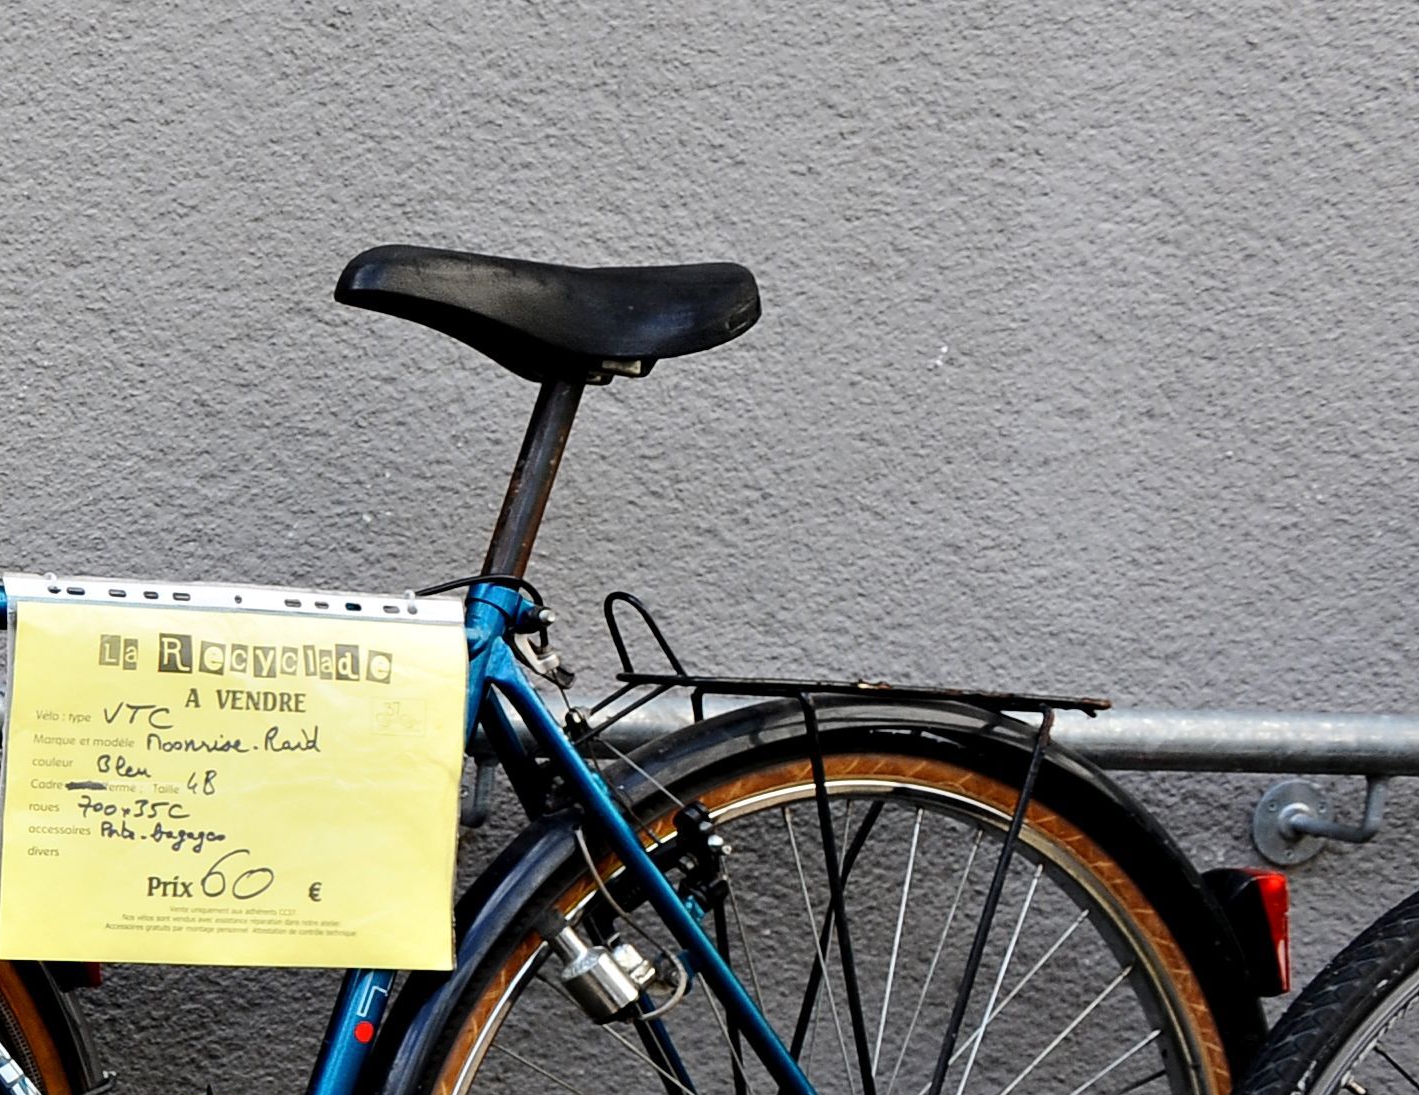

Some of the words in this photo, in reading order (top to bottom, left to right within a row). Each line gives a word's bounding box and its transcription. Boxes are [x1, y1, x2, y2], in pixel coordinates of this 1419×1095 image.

[158, 633, 393, 684] Recyclade
[185, 688, 201, 708] A
[216, 688, 307, 713] VENDRE
[68, 711, 91, 724] type
[104, 701, 174, 730] VTC
[33, 734, 76, 747] Marque
[79, 736, 91, 747] et
[92, 735, 135, 748] modèle
[32, 756, 74, 769] couleur
[97, 754, 151, 778] Bleu
[30, 778, 63, 791] Cadre
[153, 783, 180, 795] Taille
[28, 801, 60, 813] roues
[28, 822, 91, 836] accessoires
[27, 845, 60, 858] divers
[147, 875, 194, 897] Prix
[200, 849, 274, 900] 60
[308, 881, 322, 902] €
